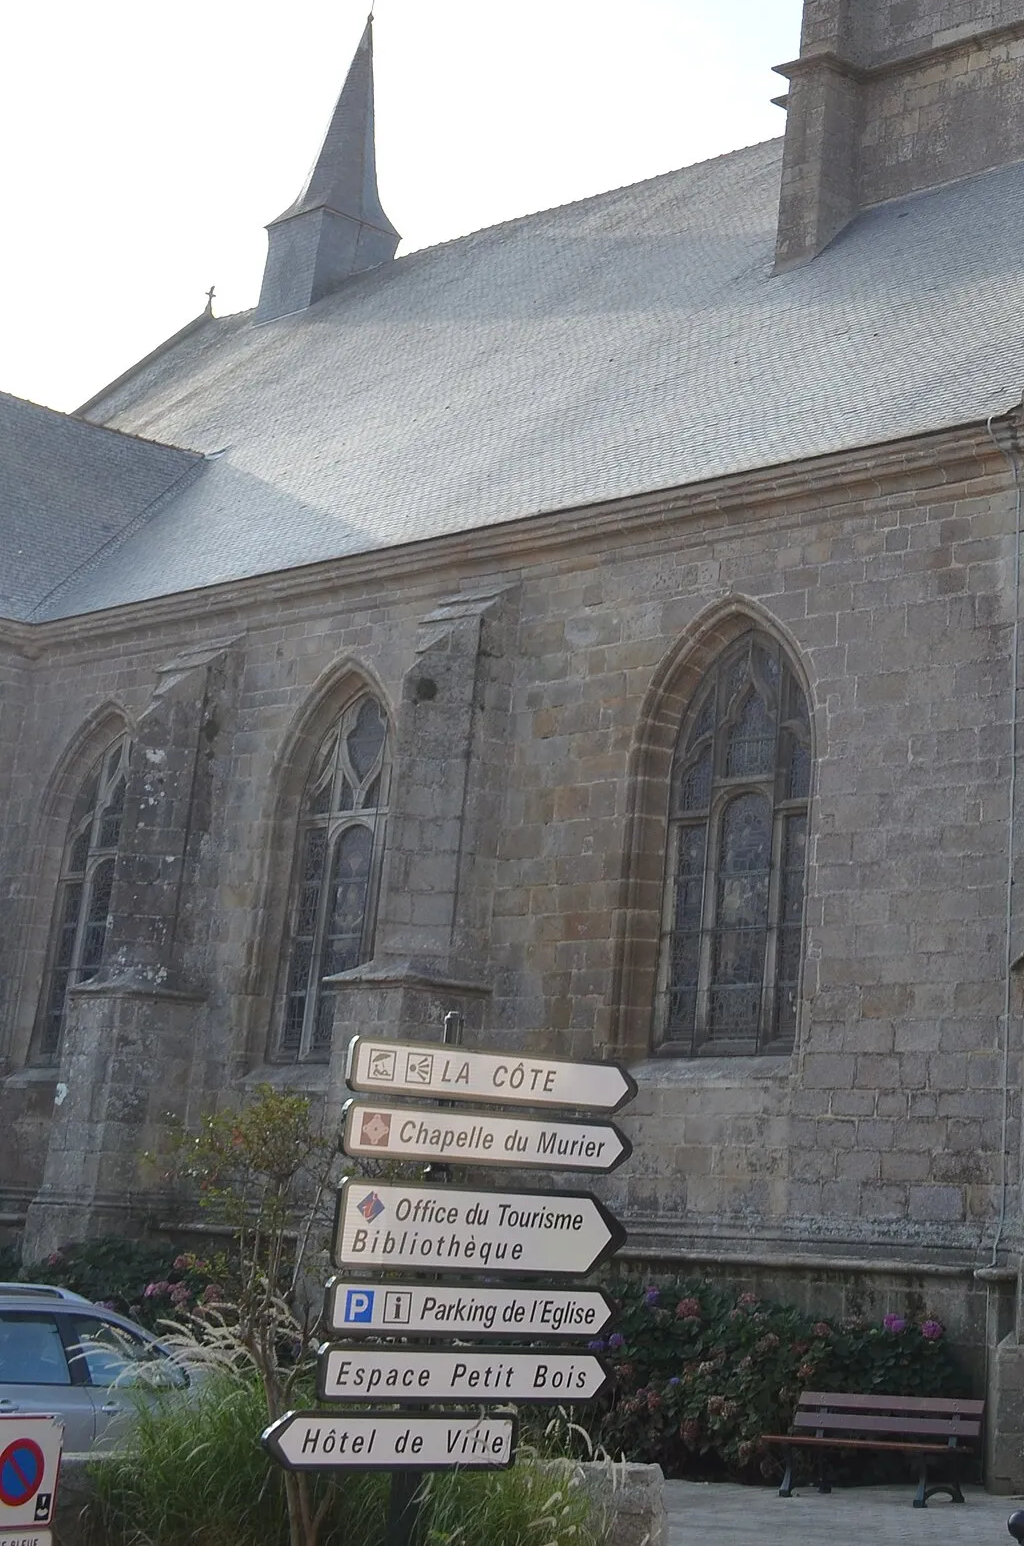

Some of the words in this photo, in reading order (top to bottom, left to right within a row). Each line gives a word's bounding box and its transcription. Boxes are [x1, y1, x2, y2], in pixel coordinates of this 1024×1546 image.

[441, 1060, 470, 1084] LA
[492, 1062, 557, 1092] CÔTE
[399, 1120, 494, 1152] Chapelle
[504, 1129, 528, 1153] du
[536, 1131, 605, 1158] Murier
[395, 1198, 458, 1224] Office
[465, 1203, 489, 1226] du
[498, 1205, 583, 1230] Tourisme
[351, 1229, 523, 1265] Bibliothèque
[349, 1293, 369, 1321] P
[420, 1297, 496, 1329] Parking
[502, 1300, 525, 1323] de
[529, 1300, 596, 1330] l'Eglise
[335, 1361, 431, 1392] Espace
[450, 1363, 515, 1387] Petit
[533, 1364, 587, 1388] Bois
[301, 1428, 376, 1454] Hôtel
[394, 1429, 424, 1454] de
[447, 1429, 503, 1454] Ville
